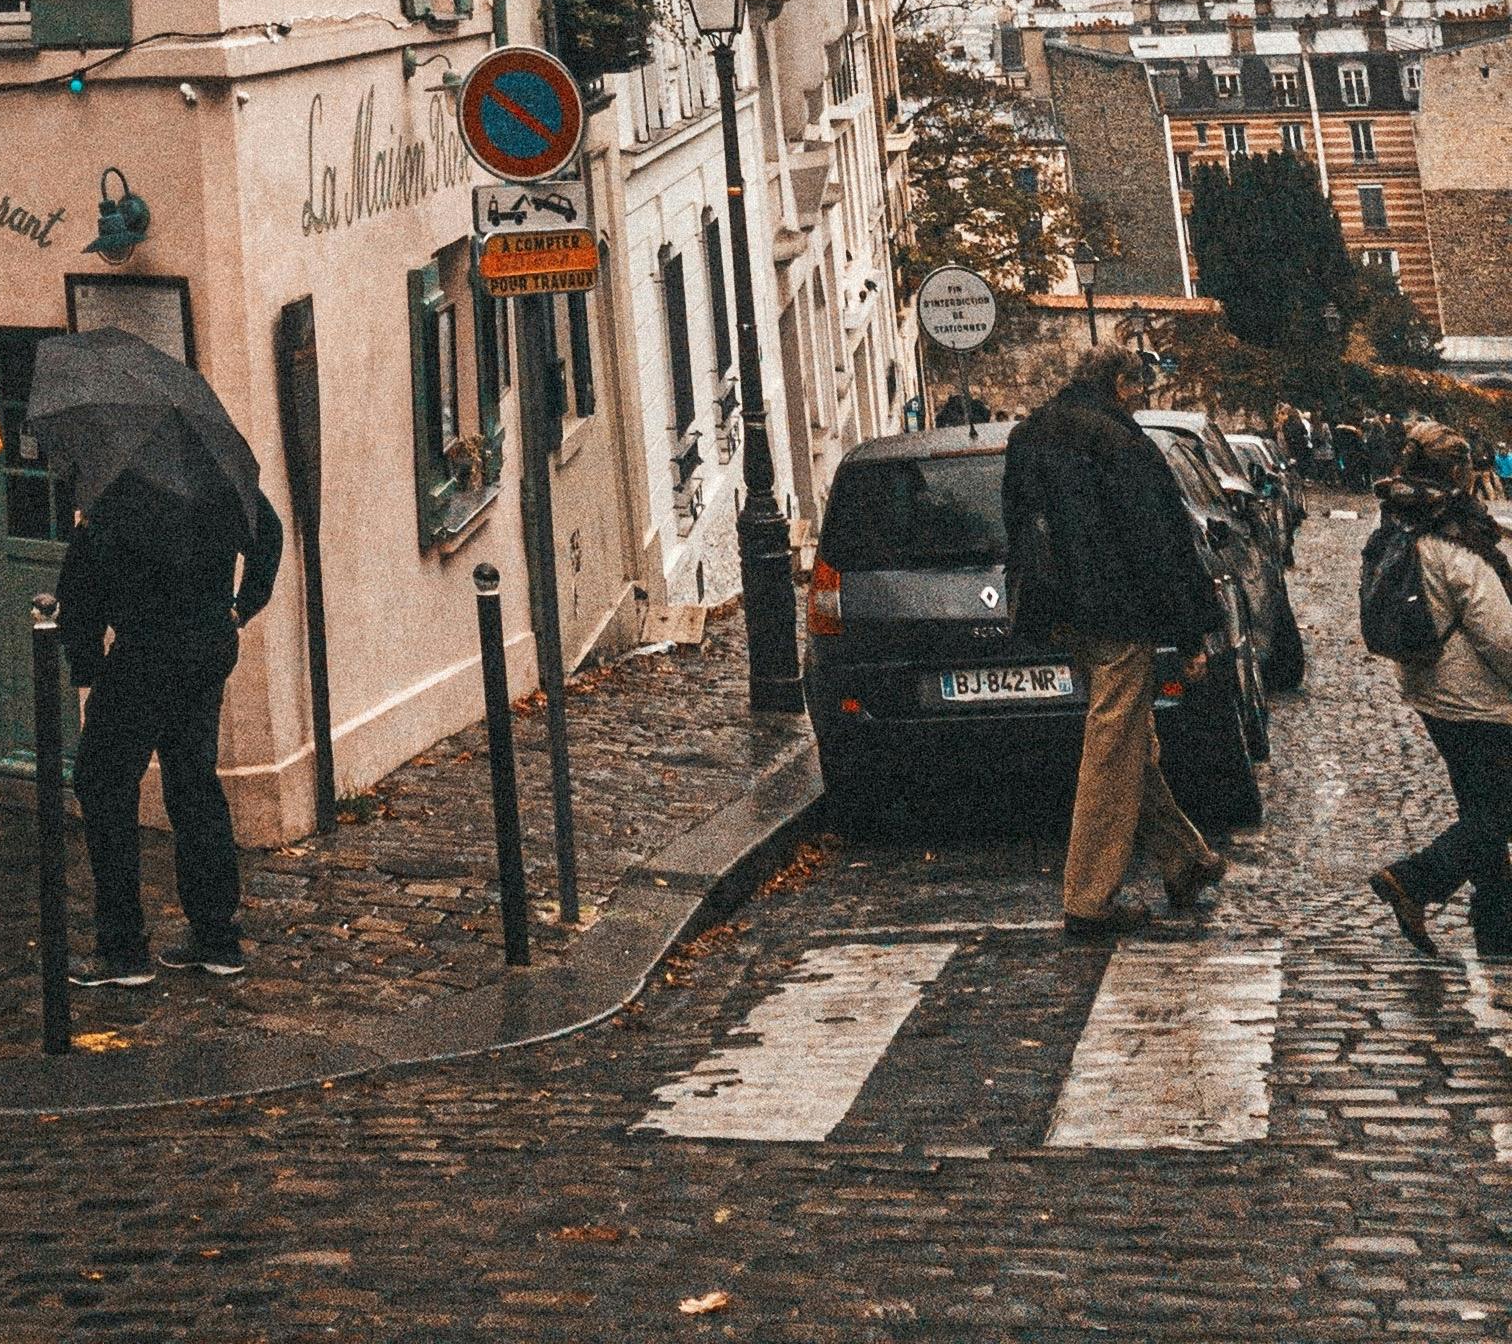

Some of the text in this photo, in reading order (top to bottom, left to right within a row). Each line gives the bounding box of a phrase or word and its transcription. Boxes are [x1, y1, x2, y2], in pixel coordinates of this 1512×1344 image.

[302, 93, 340, 237] La
[344, 84, 428, 227] Maison
[515, 234, 580, 252] COMPTER
[490, 272, 594, 293] POUR TRAVAUX
[948, 285, 962, 294] FIN
[934, 322, 987, 334] STATIONNER
